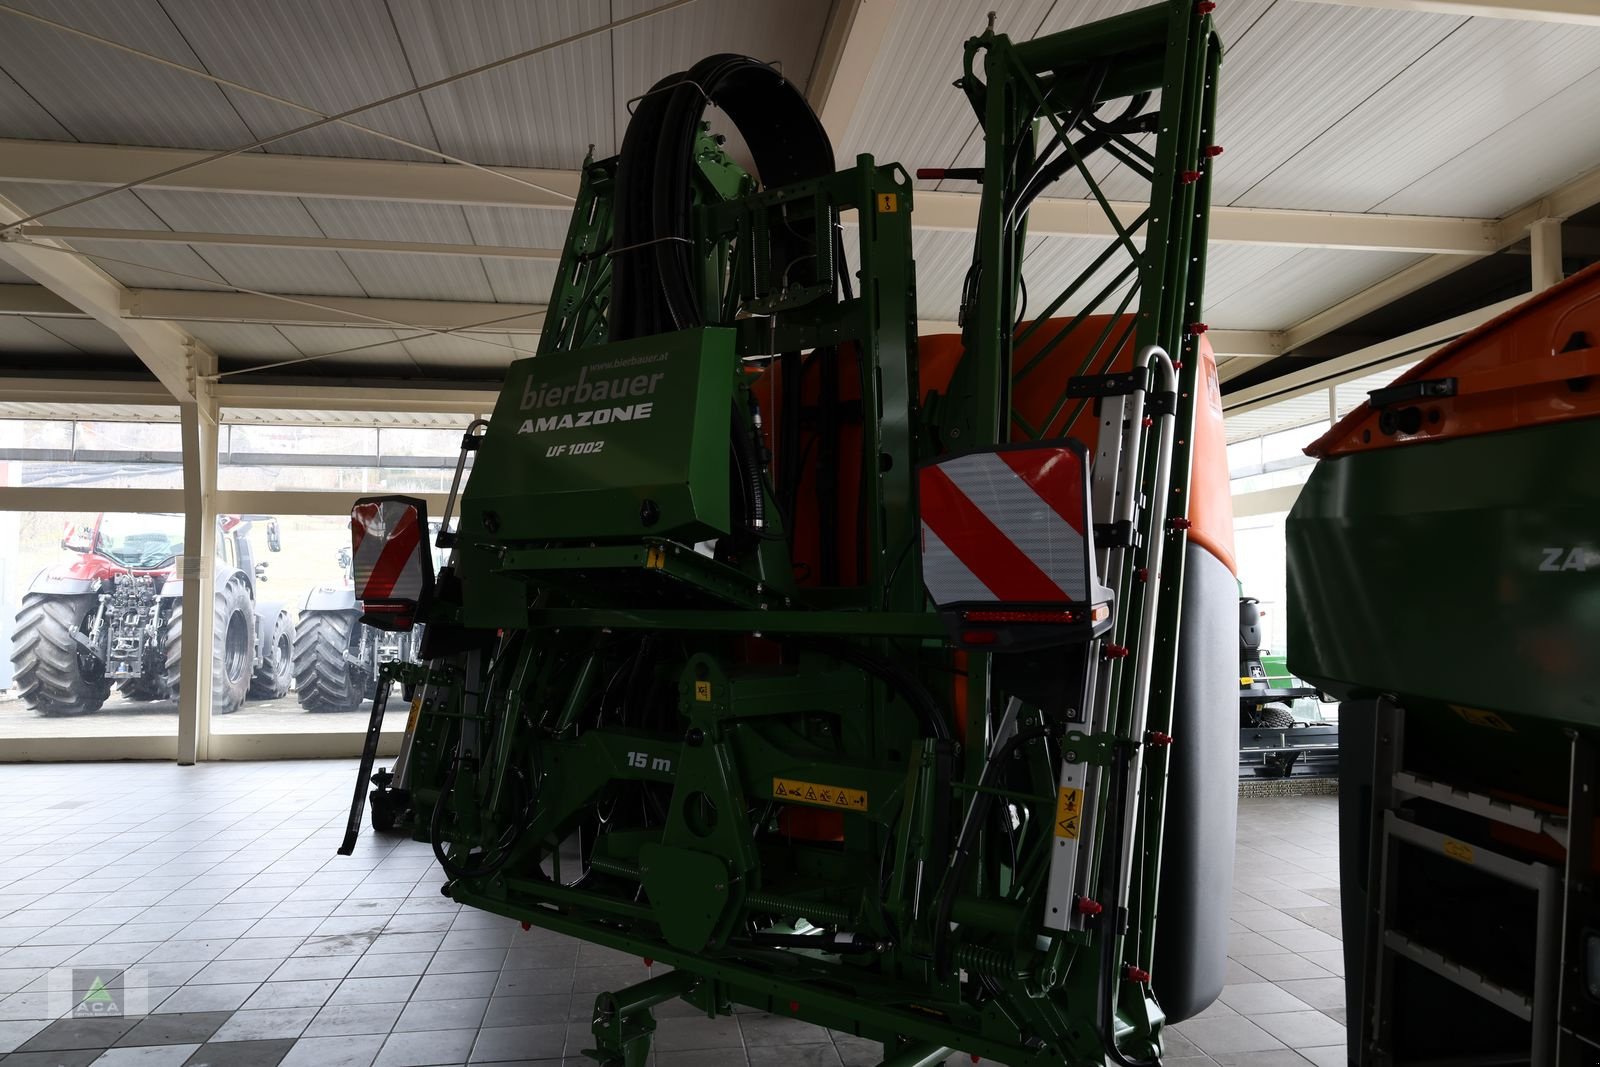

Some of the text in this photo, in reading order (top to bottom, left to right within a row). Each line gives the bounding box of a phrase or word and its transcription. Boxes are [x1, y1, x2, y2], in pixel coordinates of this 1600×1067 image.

[590, 352, 669, 372] www.bierbauer.at
[520, 366, 664, 411] bierbauer
[517, 402, 653, 435] AMAZONE
[545, 441, 605, 458] UF 1002
[627, 751, 672, 772] 15 m
